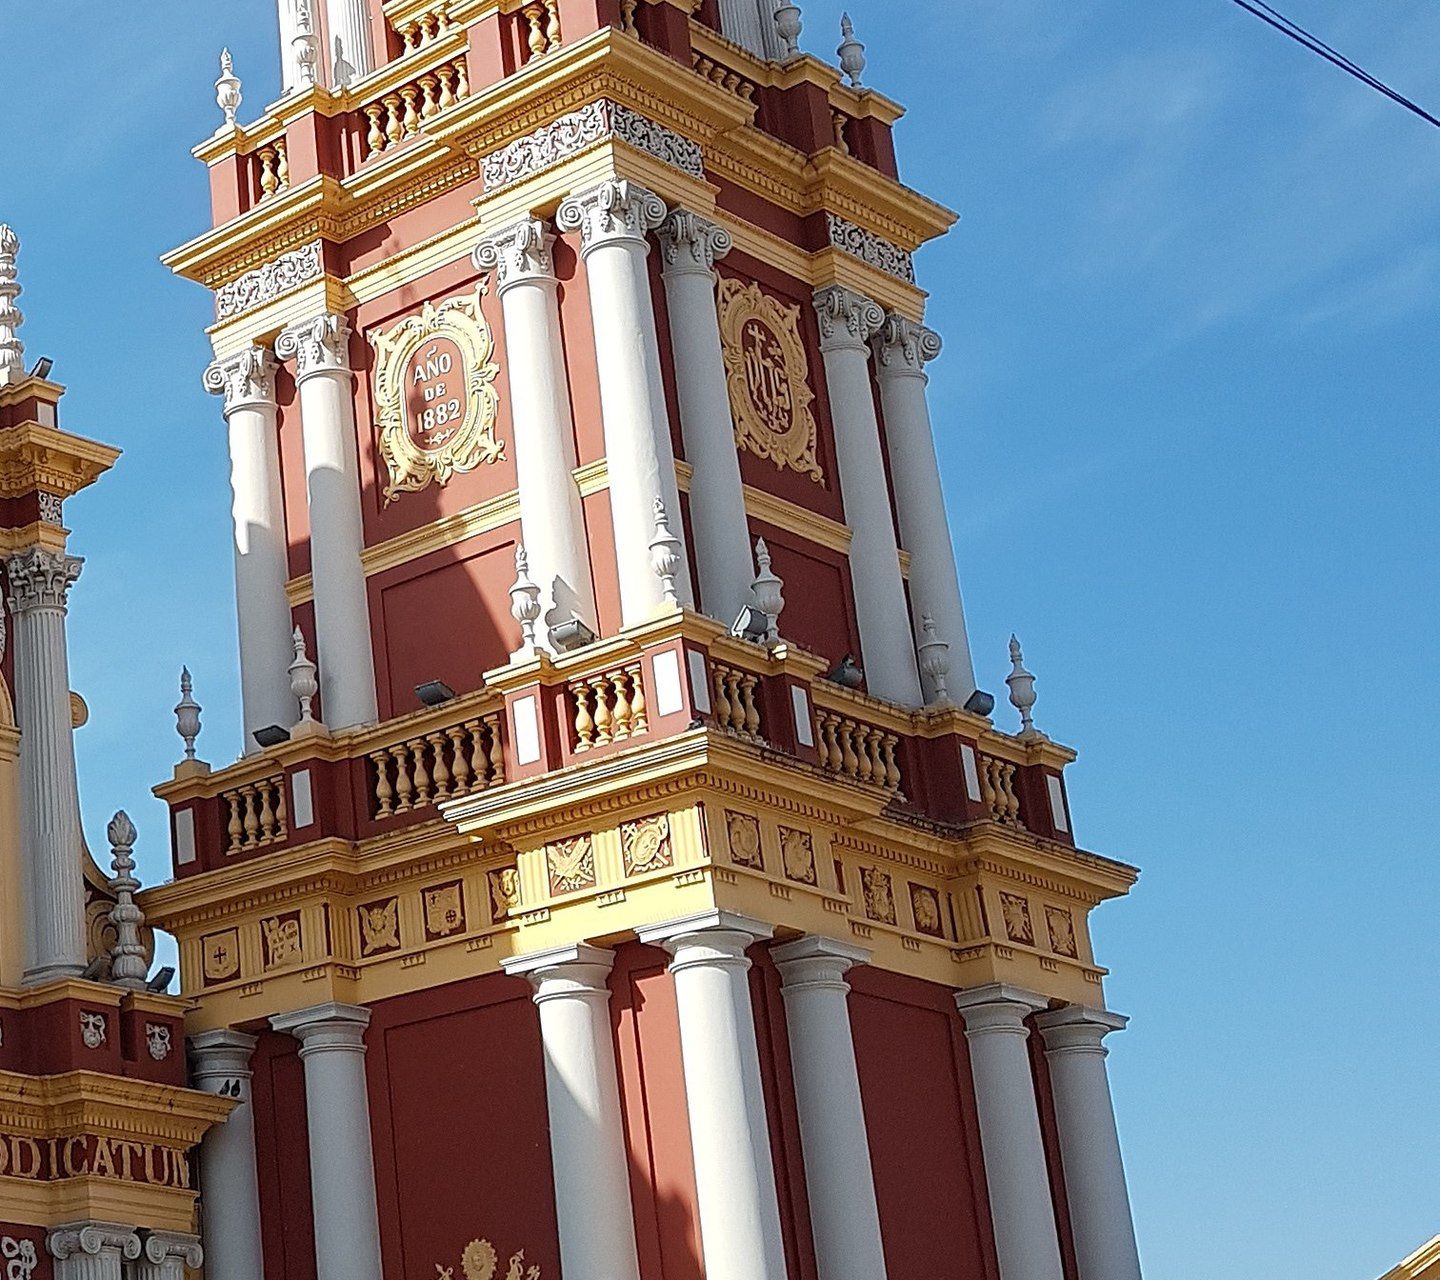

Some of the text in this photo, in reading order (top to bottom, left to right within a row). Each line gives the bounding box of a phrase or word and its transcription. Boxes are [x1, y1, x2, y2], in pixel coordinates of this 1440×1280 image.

[414, 345, 452, 387] AÑO
[424, 382, 447, 402] DE
[417, 398, 461, 434] 1882
